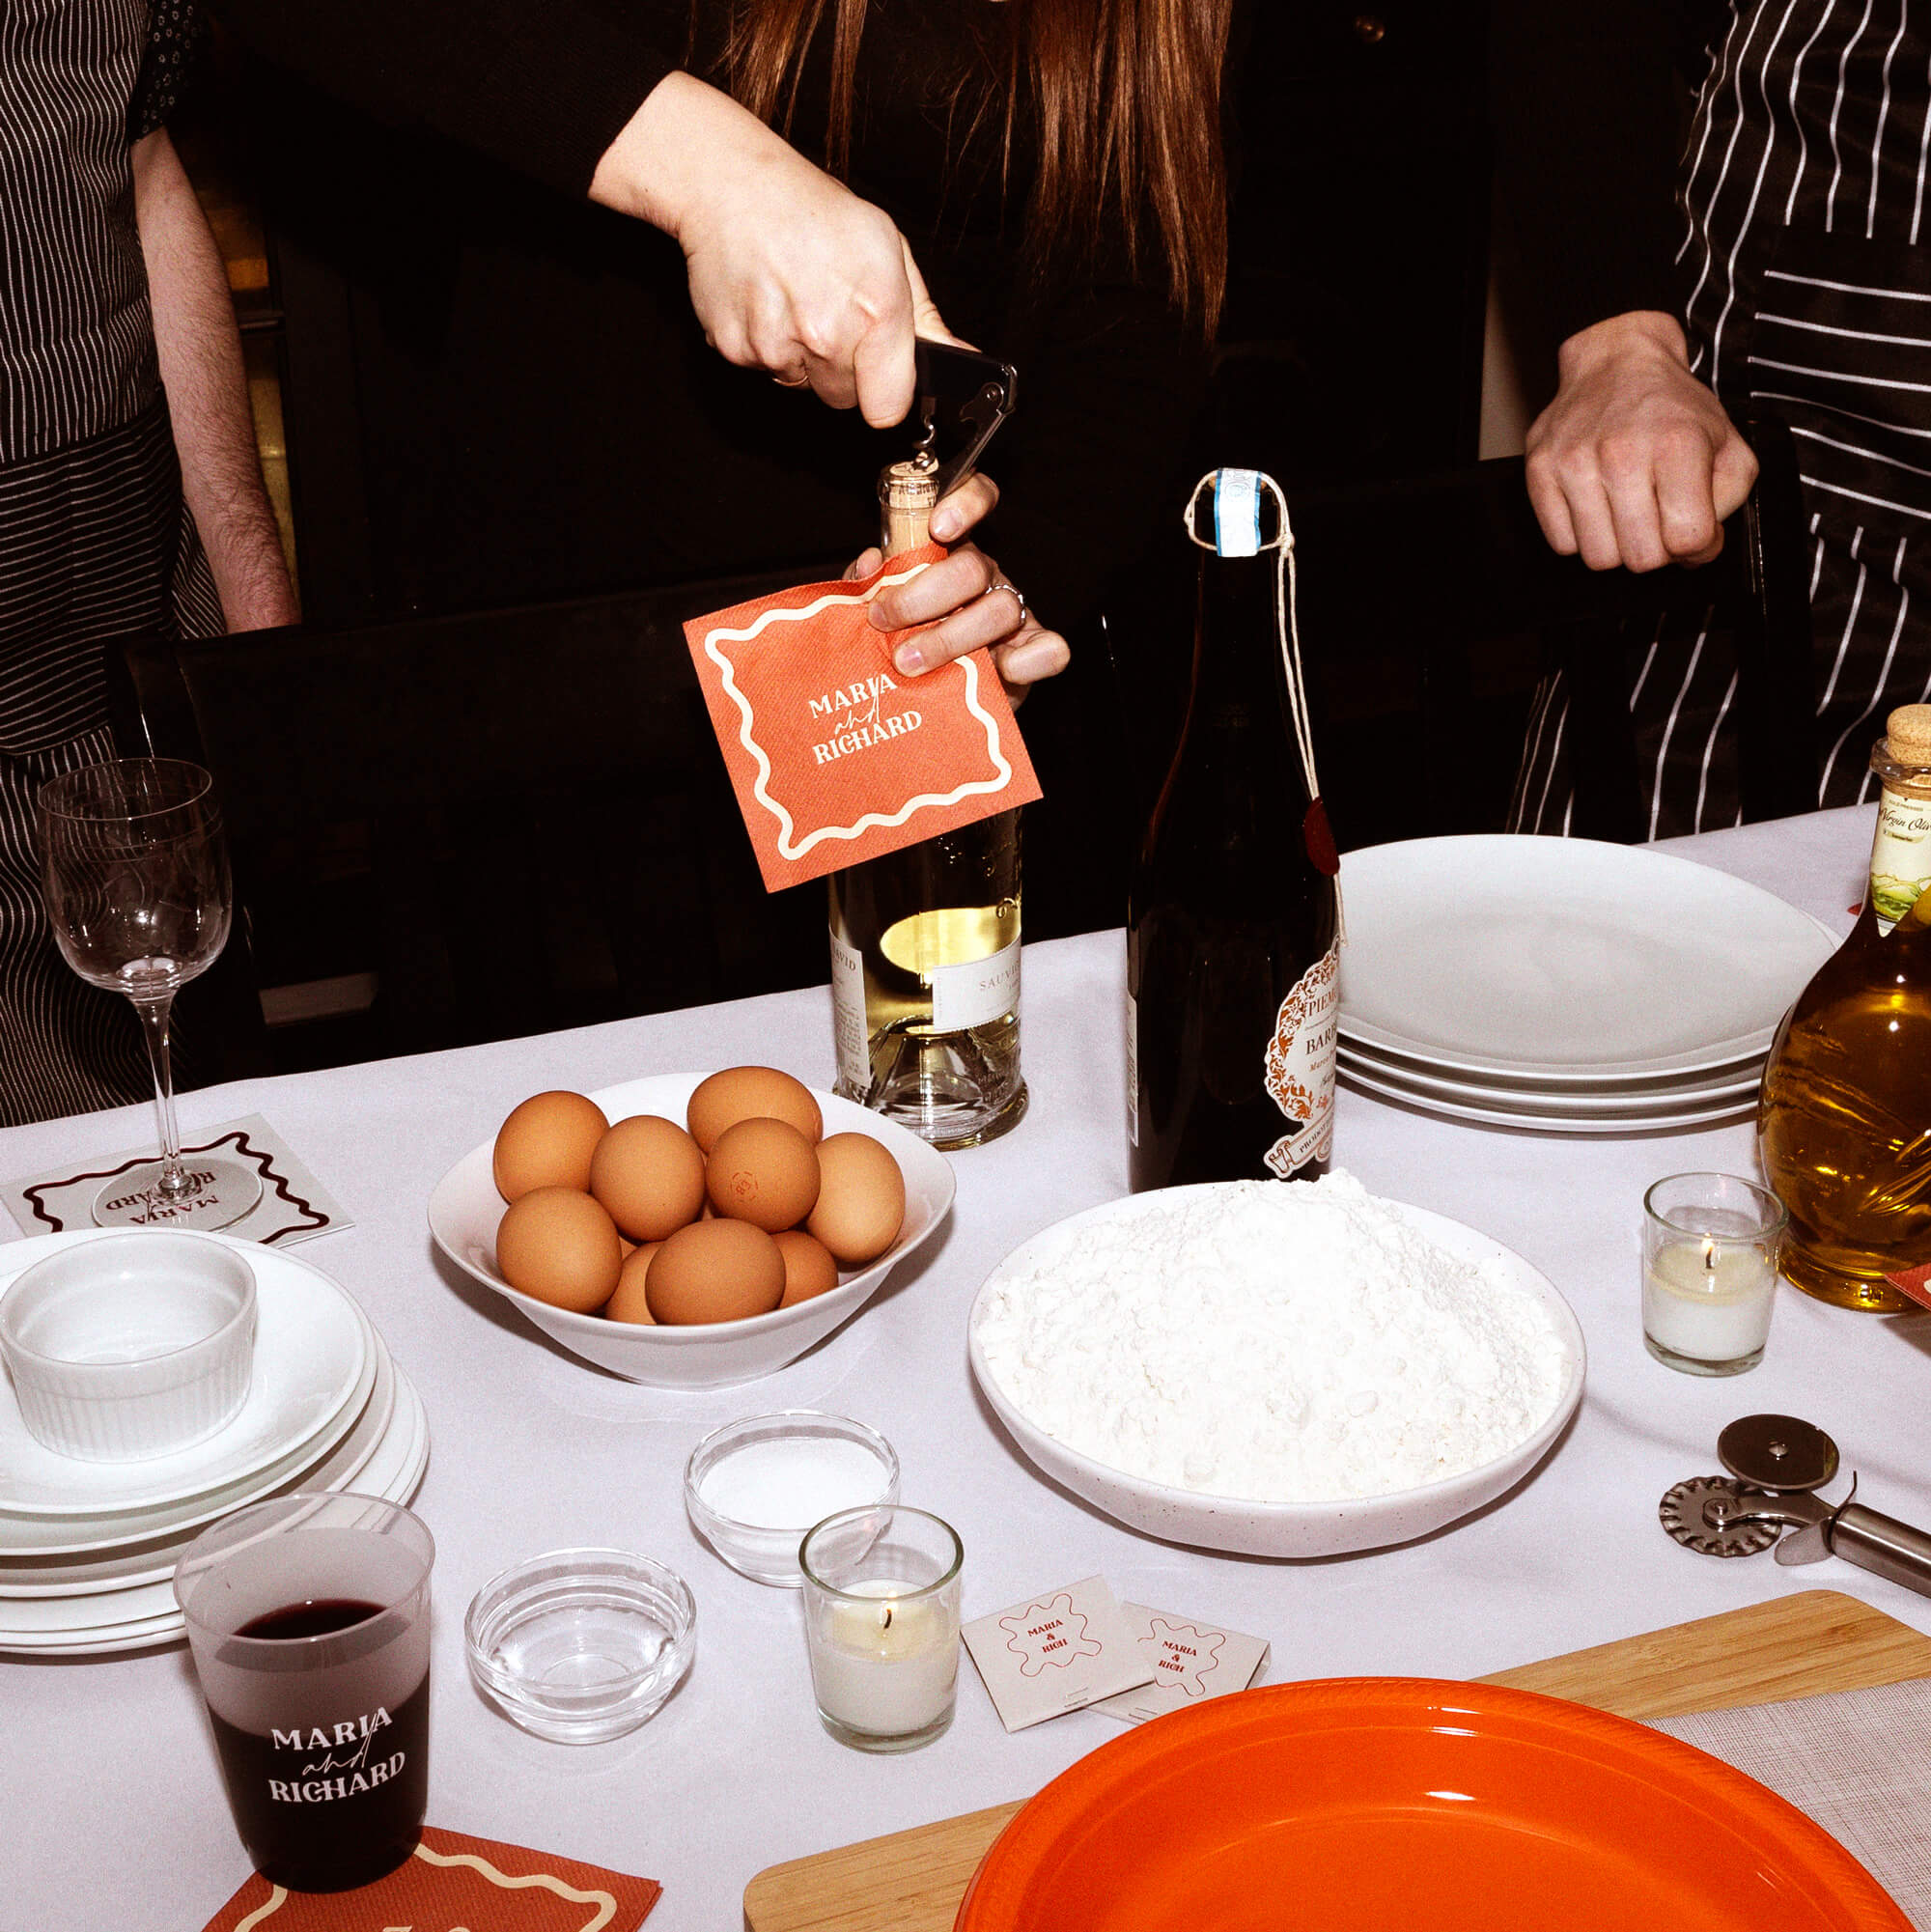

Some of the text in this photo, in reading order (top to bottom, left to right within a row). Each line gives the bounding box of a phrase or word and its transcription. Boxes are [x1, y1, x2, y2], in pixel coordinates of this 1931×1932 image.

[808, 673, 898, 718] MARIA
[833, 677, 881, 734] and
[812, 710, 923, 765] RICHARD
[1881, 807, 1931, 831] Virgin Oliv
[105, 1171, 217, 1211] RARD
[129, 1194, 219, 1224] MARIA
[1027, 1618, 1064, 1638] MARIA
[1042, 1638, 1068, 1654] RICH
[1159, 1660, 1185, 1673] RICH
[1161, 1640, 1197, 1657] MARIA
[270, 1706, 393, 1751] MARIA
[301, 1713, 378, 1777] and
[268, 1750, 406, 1803] RICHARD
